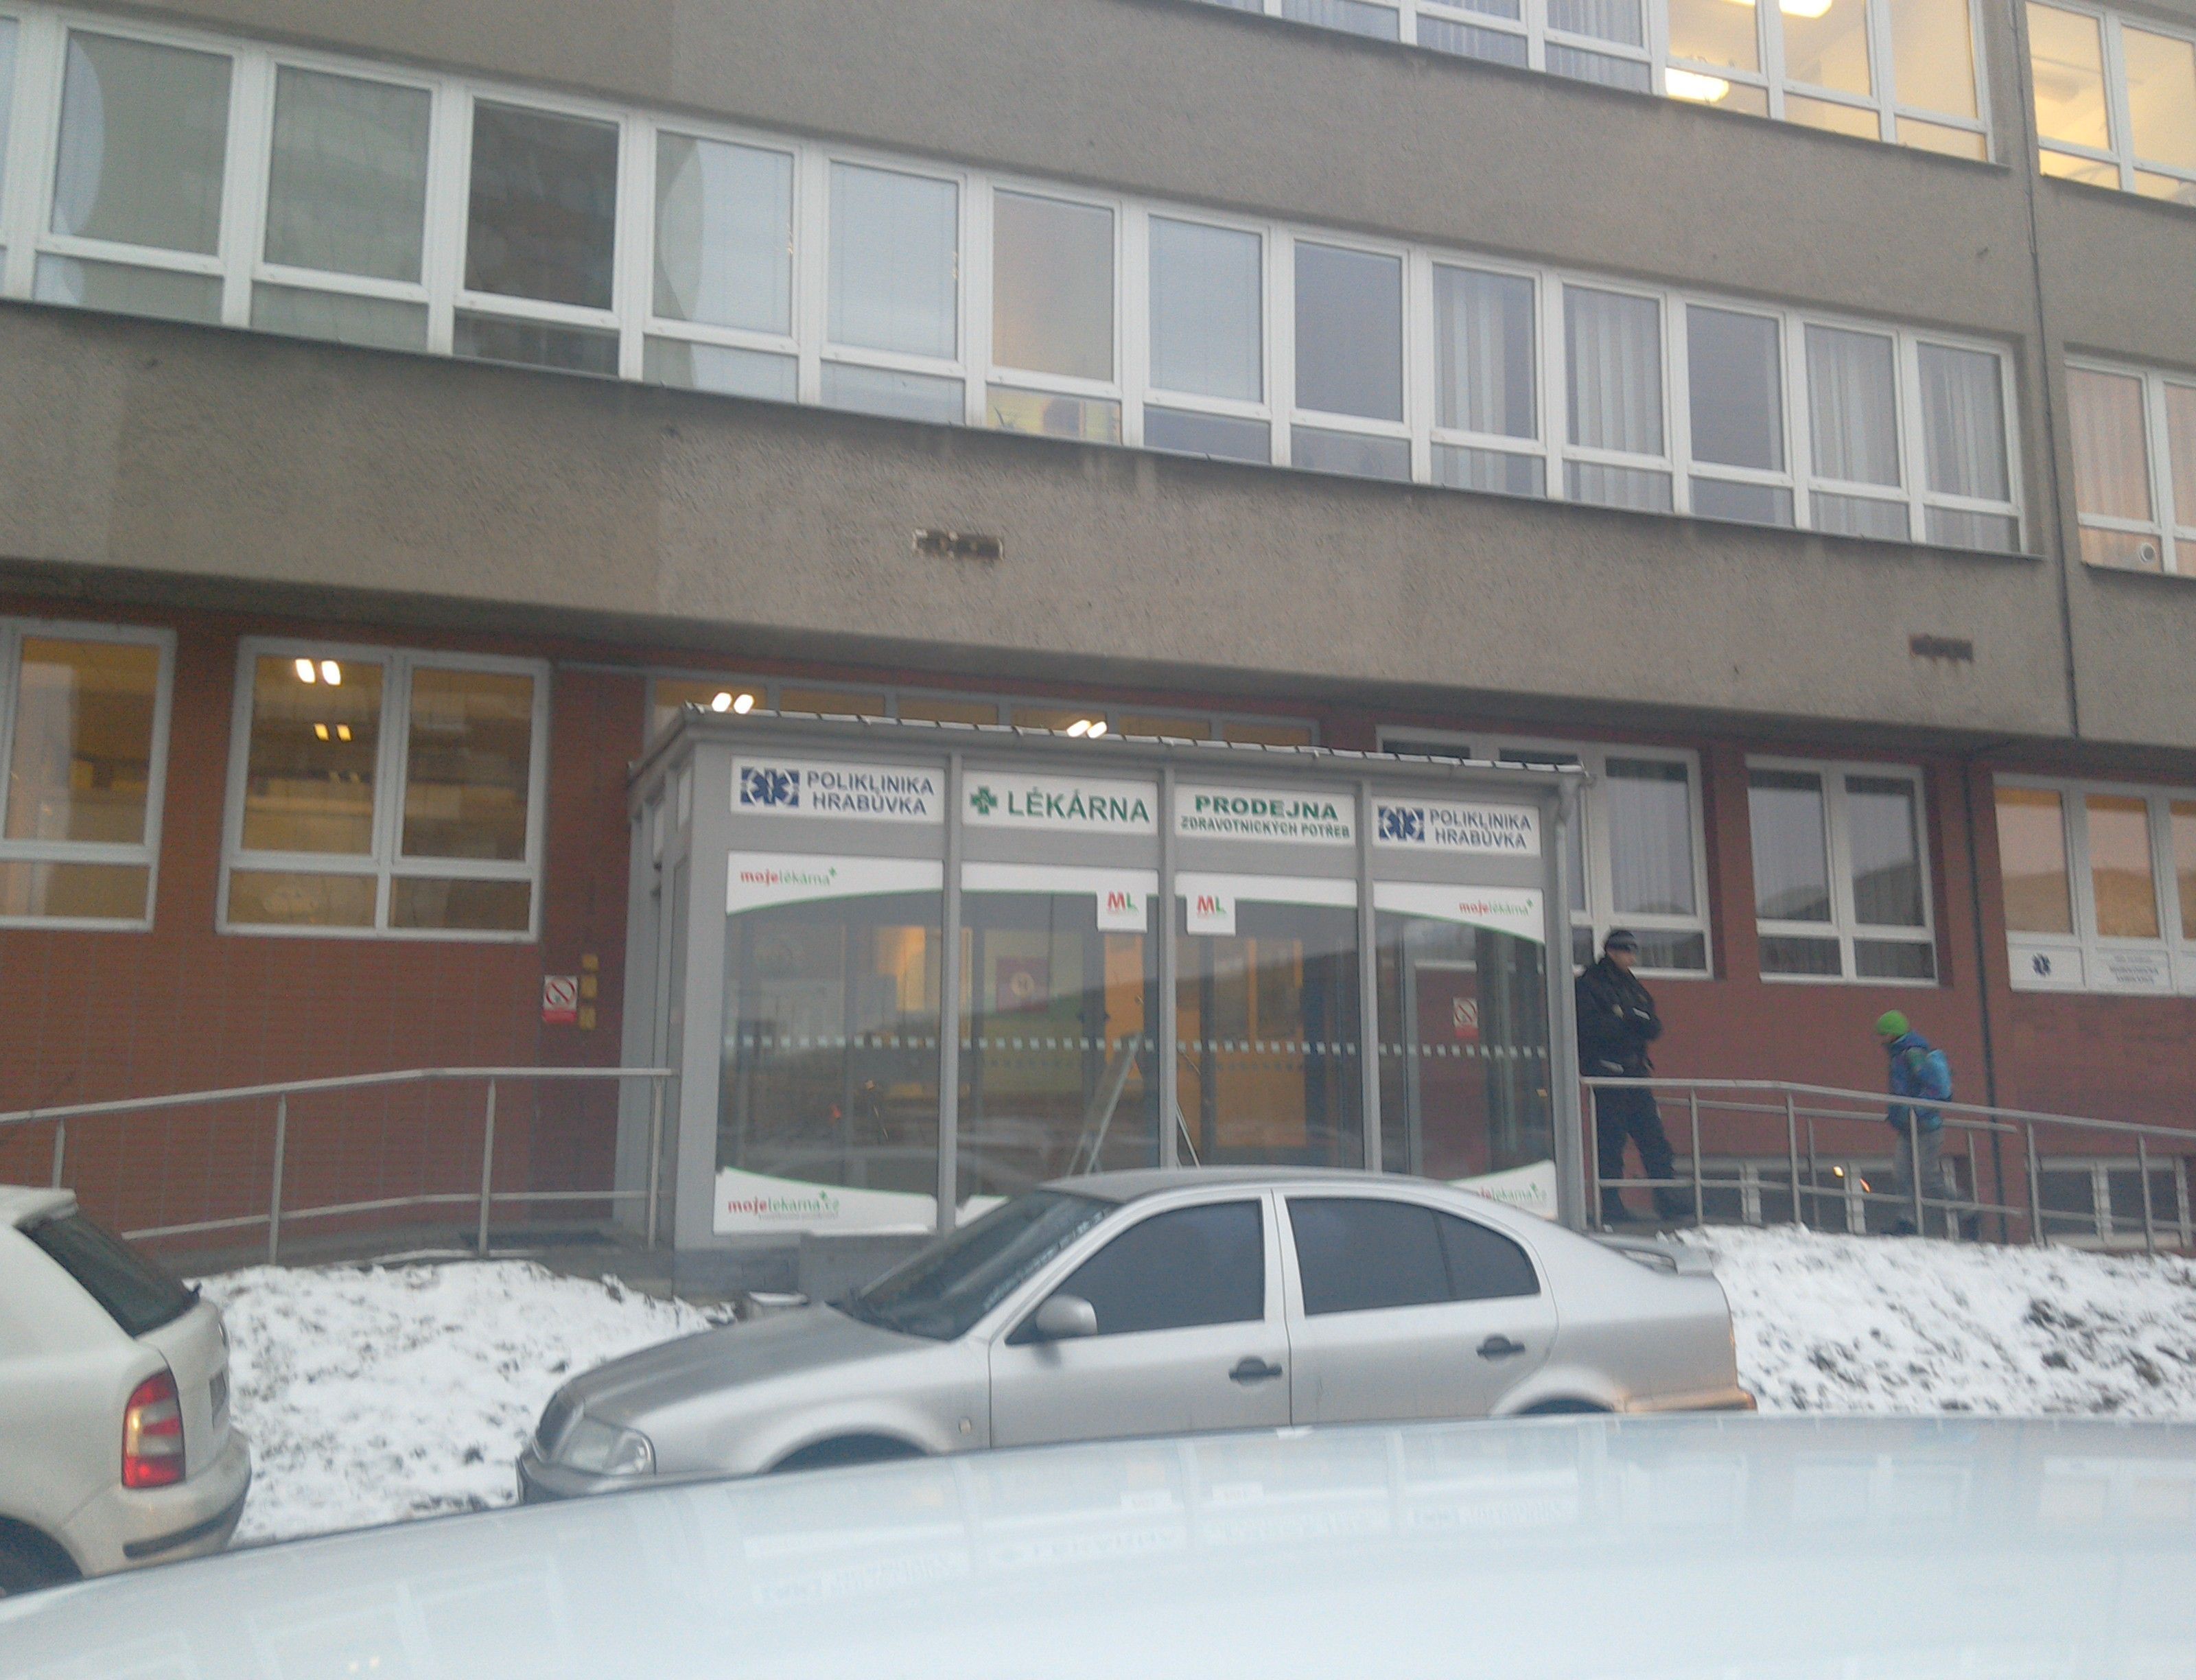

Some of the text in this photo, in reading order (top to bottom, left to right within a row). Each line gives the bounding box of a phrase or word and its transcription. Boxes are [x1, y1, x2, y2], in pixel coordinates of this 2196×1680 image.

[807, 770, 935, 796] POLIKLINIKA
[813, 789, 927, 815] HRABŮVKA
[1007, 786, 1150, 824] LÉKÁRNA
[1195, 794, 1339, 821] PRODEJNA
[1429, 808, 1532, 832] POLIKLINIKA
[1107, 890, 1139, 913] ML
[1197, 894, 1226, 915] ML
